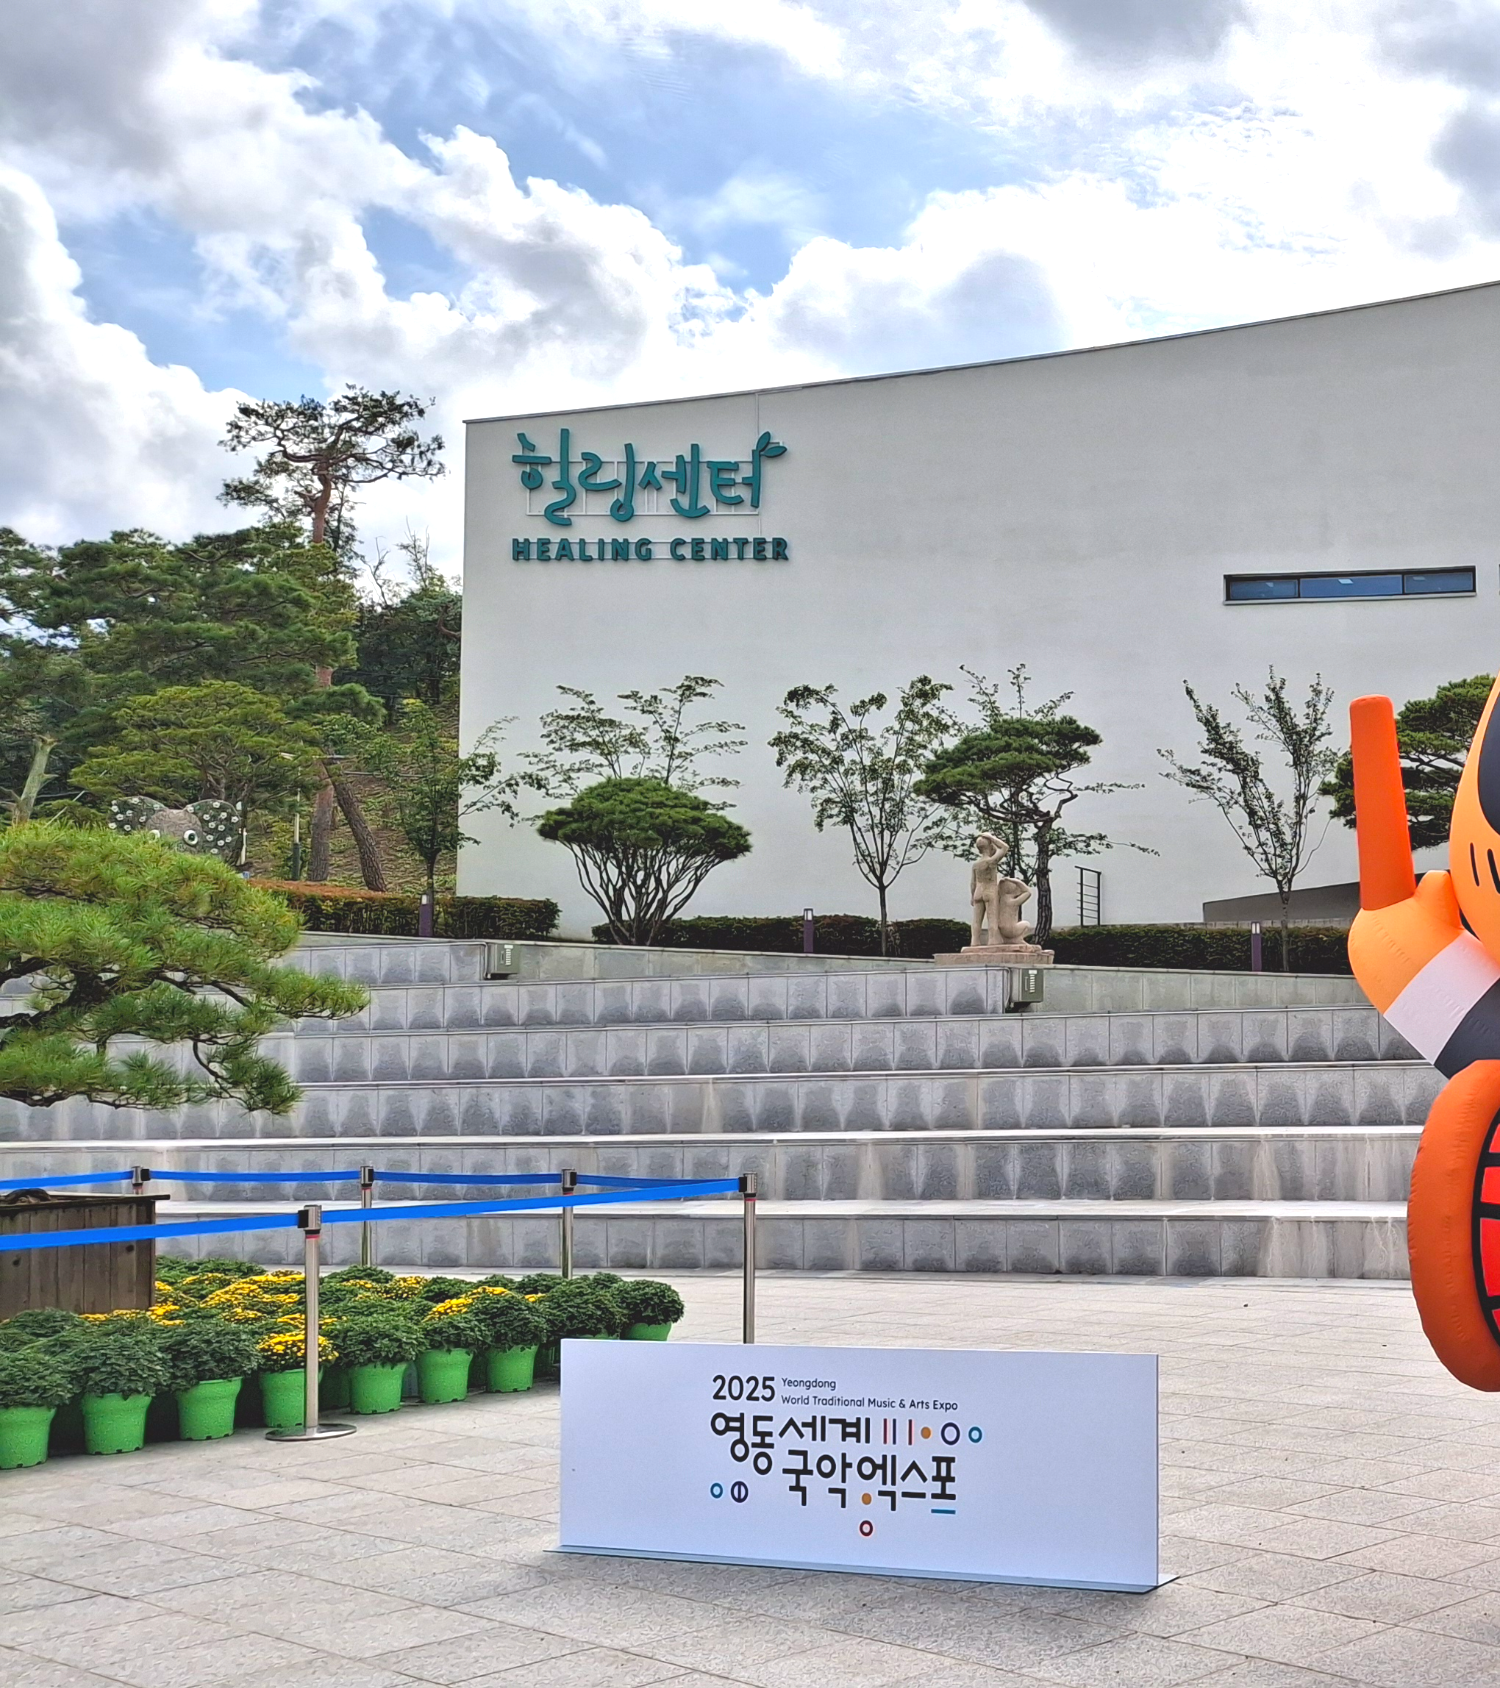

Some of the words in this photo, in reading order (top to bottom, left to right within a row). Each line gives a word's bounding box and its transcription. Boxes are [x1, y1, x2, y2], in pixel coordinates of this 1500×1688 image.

[511, 428, 787, 526] 힐링센터
[511, 537, 653, 562] HEALING
[669, 536, 789, 562] CENTER
[712, 1374, 776, 1402] 2025
[781, 1377, 837, 1391] Yeongdong
[781, 1394, 810, 1406] World
[812, 1395, 865, 1408] Traditional
[867, 1397, 896, 1409] Music
[898, 1398, 906, 1409] &
[908, 1399, 930, 1411] Arts
[932, 1399, 959, 1412] Expo
[710, 1411, 871, 1476] 영동세계
[781, 1449, 957, 1512] 국악엑스포
